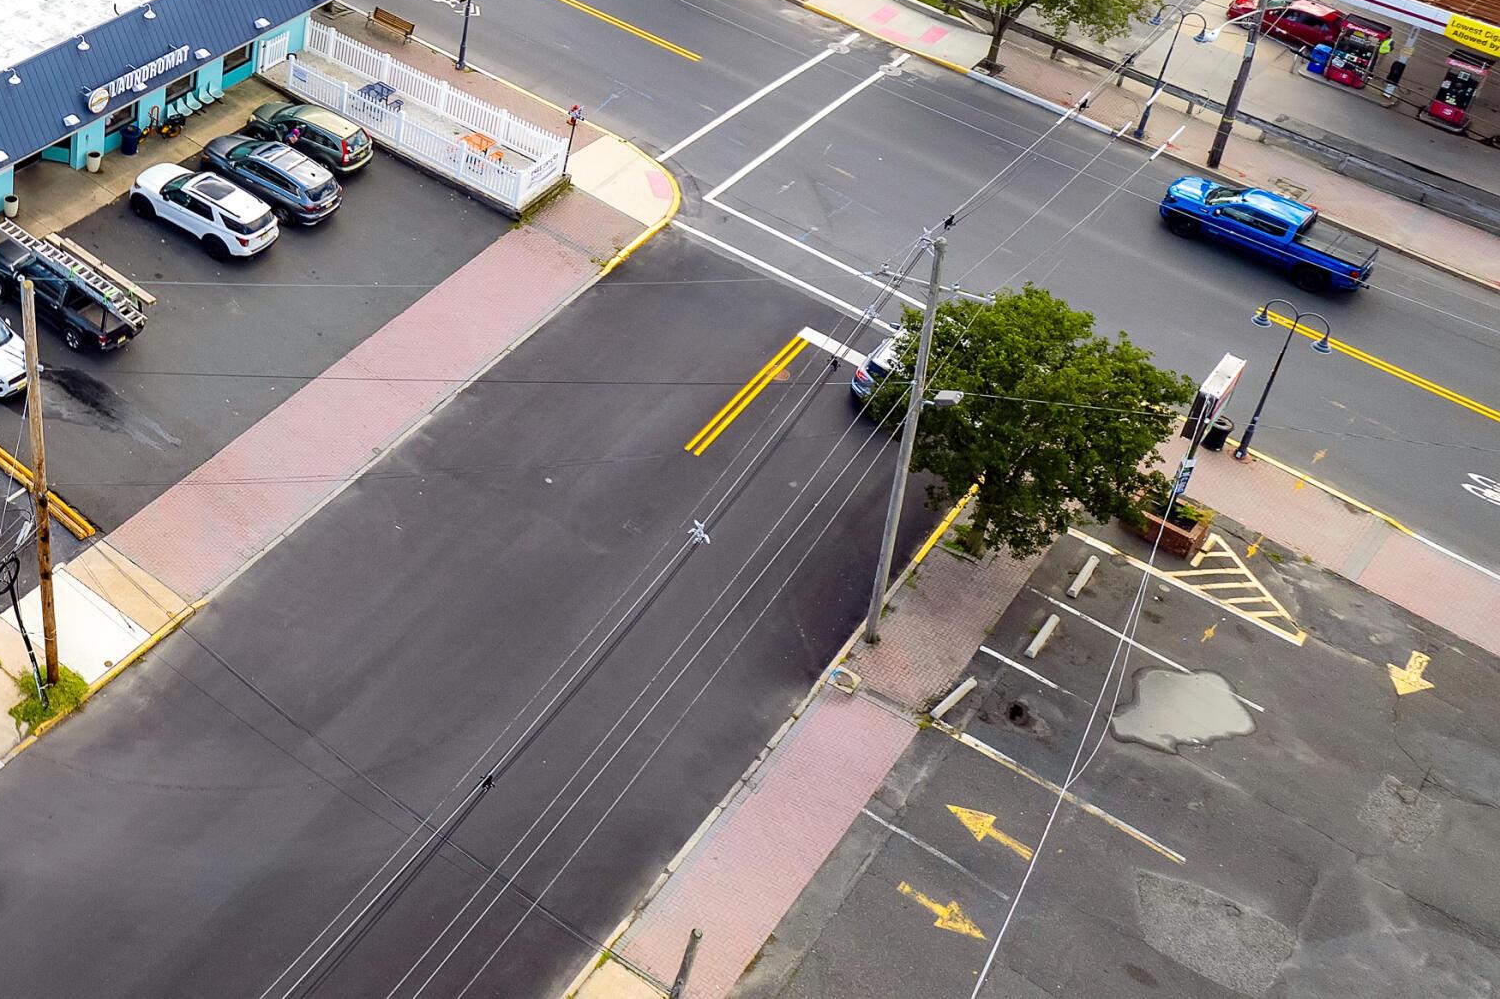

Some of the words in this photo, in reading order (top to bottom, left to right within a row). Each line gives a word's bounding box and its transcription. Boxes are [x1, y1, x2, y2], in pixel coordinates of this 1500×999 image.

[1451, 20, 1483, 36] Lowest
[1452, 30, 1488, 46] Allowed
[1489, 43, 1500, 51] by
[109, 45, 189, 97] LAUNDROMAT
